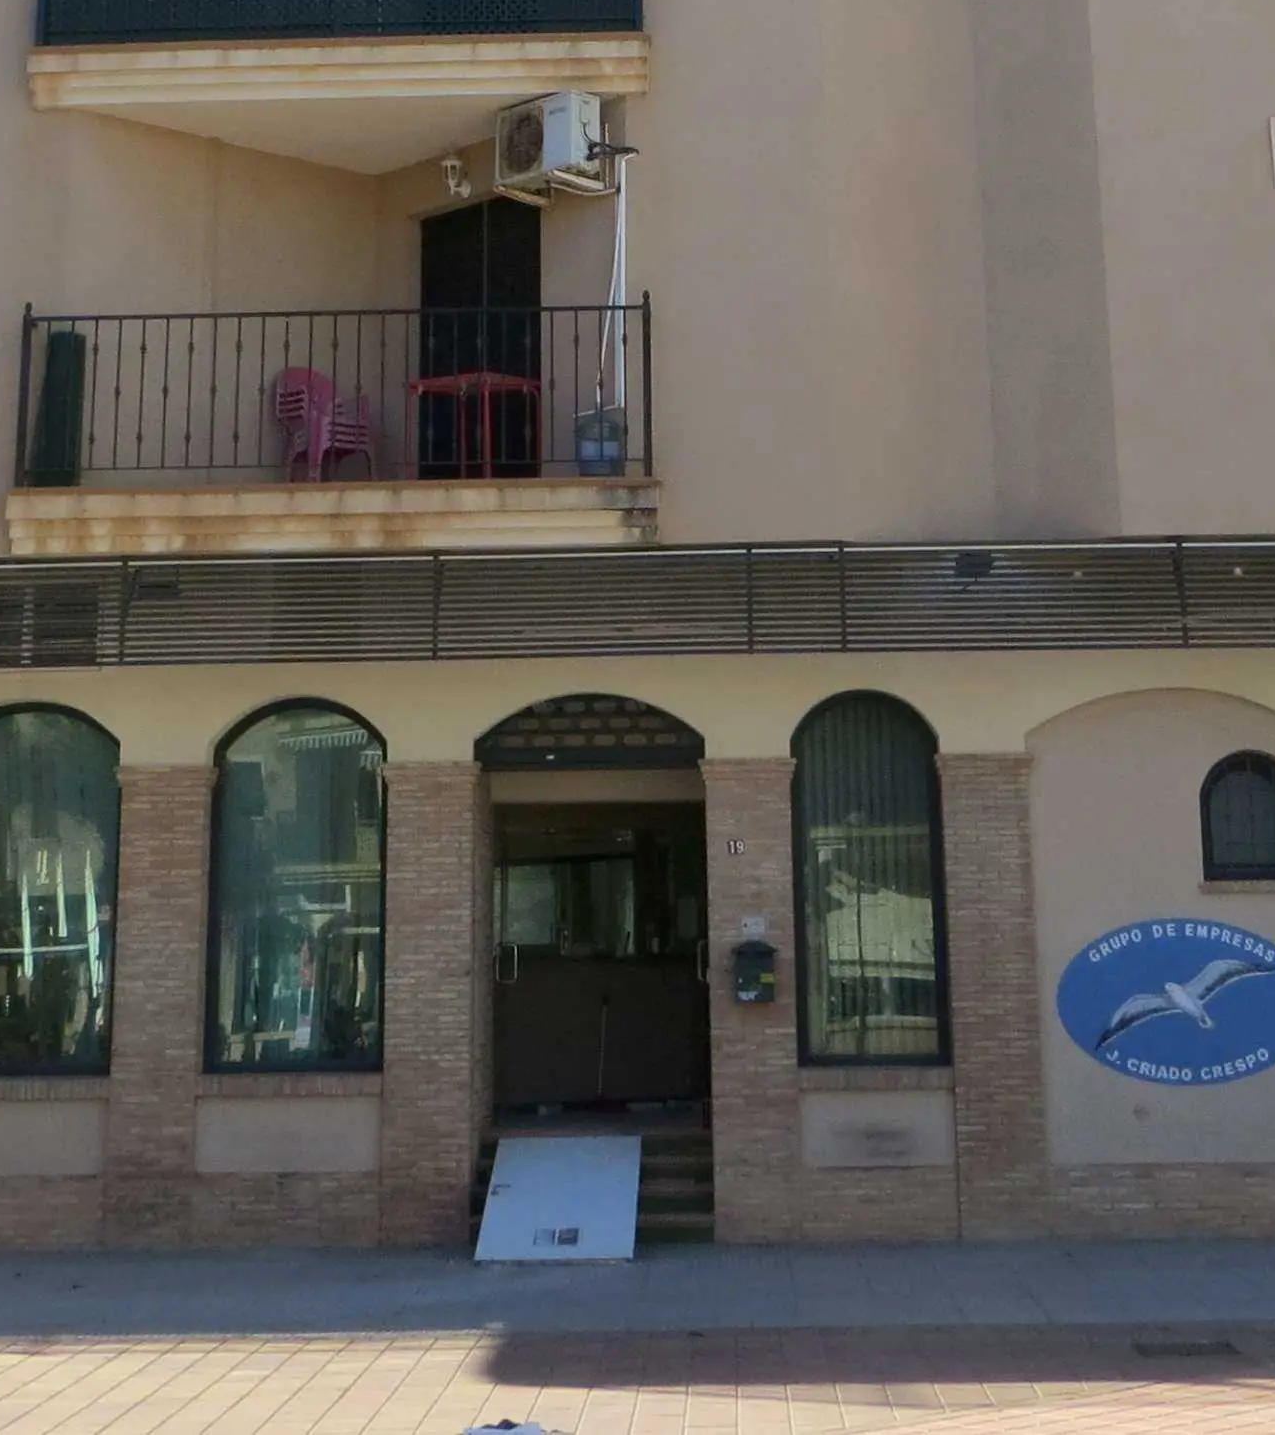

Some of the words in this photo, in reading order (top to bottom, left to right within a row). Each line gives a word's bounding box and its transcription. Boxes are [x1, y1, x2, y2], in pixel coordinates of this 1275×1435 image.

[728, 840, 745, 854] 19
[1088, 928, 1142, 963] GRUPO
[1152, 923, 1176, 938] DE
[1185, 922, 1275, 963] EMPRESAS
[1106, 1050, 1121, 1064] J.
[1127, 1057, 1192, 1082] CRIADO
[1201, 1048, 1269, 1081] CRESPO
